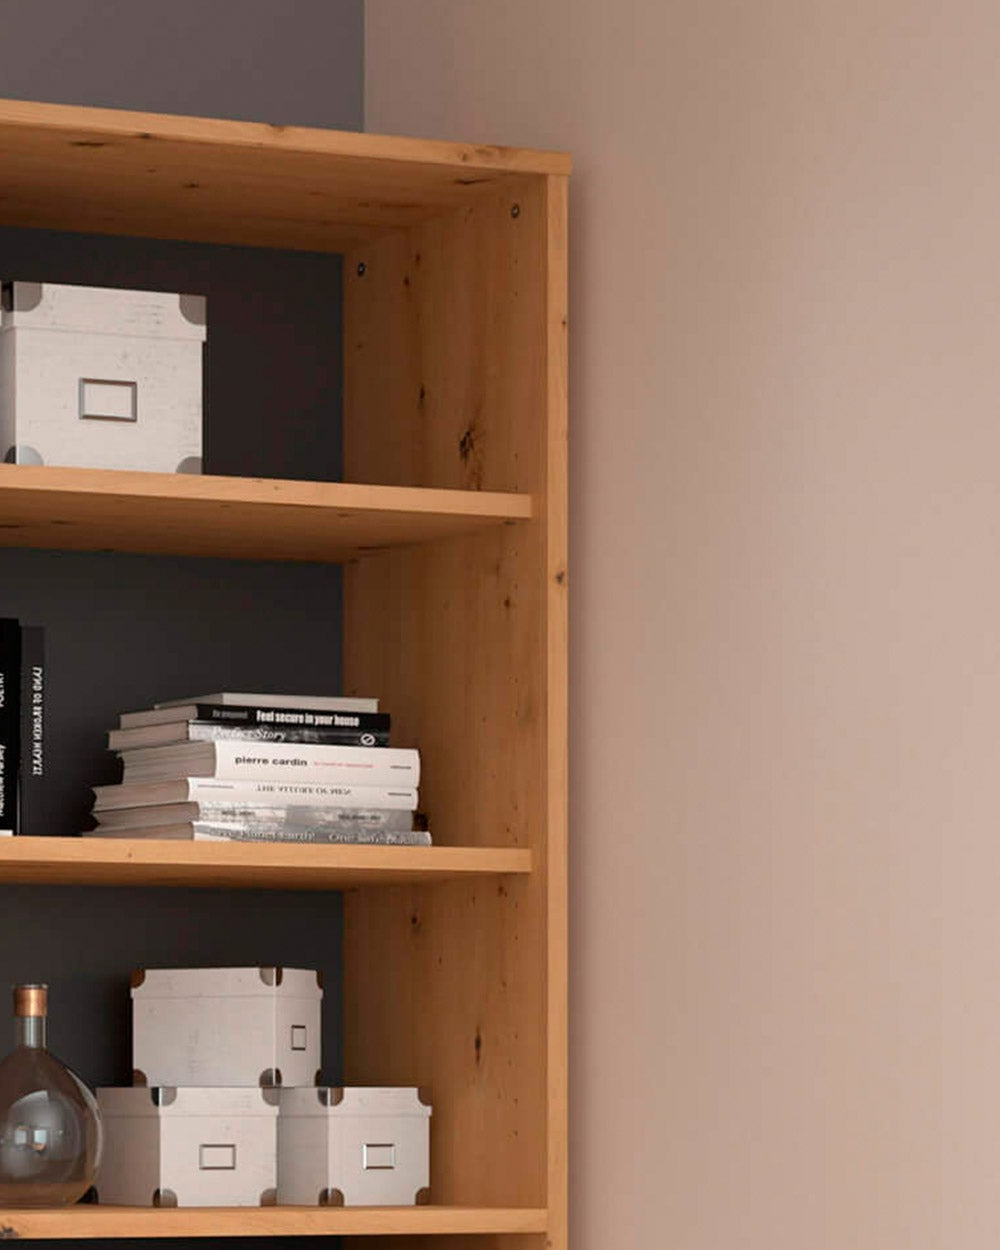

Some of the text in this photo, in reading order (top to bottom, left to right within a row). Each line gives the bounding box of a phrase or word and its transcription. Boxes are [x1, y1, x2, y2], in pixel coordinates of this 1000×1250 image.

[256, 710, 274, 722] Feel
[275, 712, 304, 724] secure
[305, 713, 313, 724] in
[314, 714, 334, 727] your
[334, 714, 360, 727] house
[256, 729, 287, 742] Story
[235, 755, 269, 767] pierre
[272, 757, 308, 767] cardin
